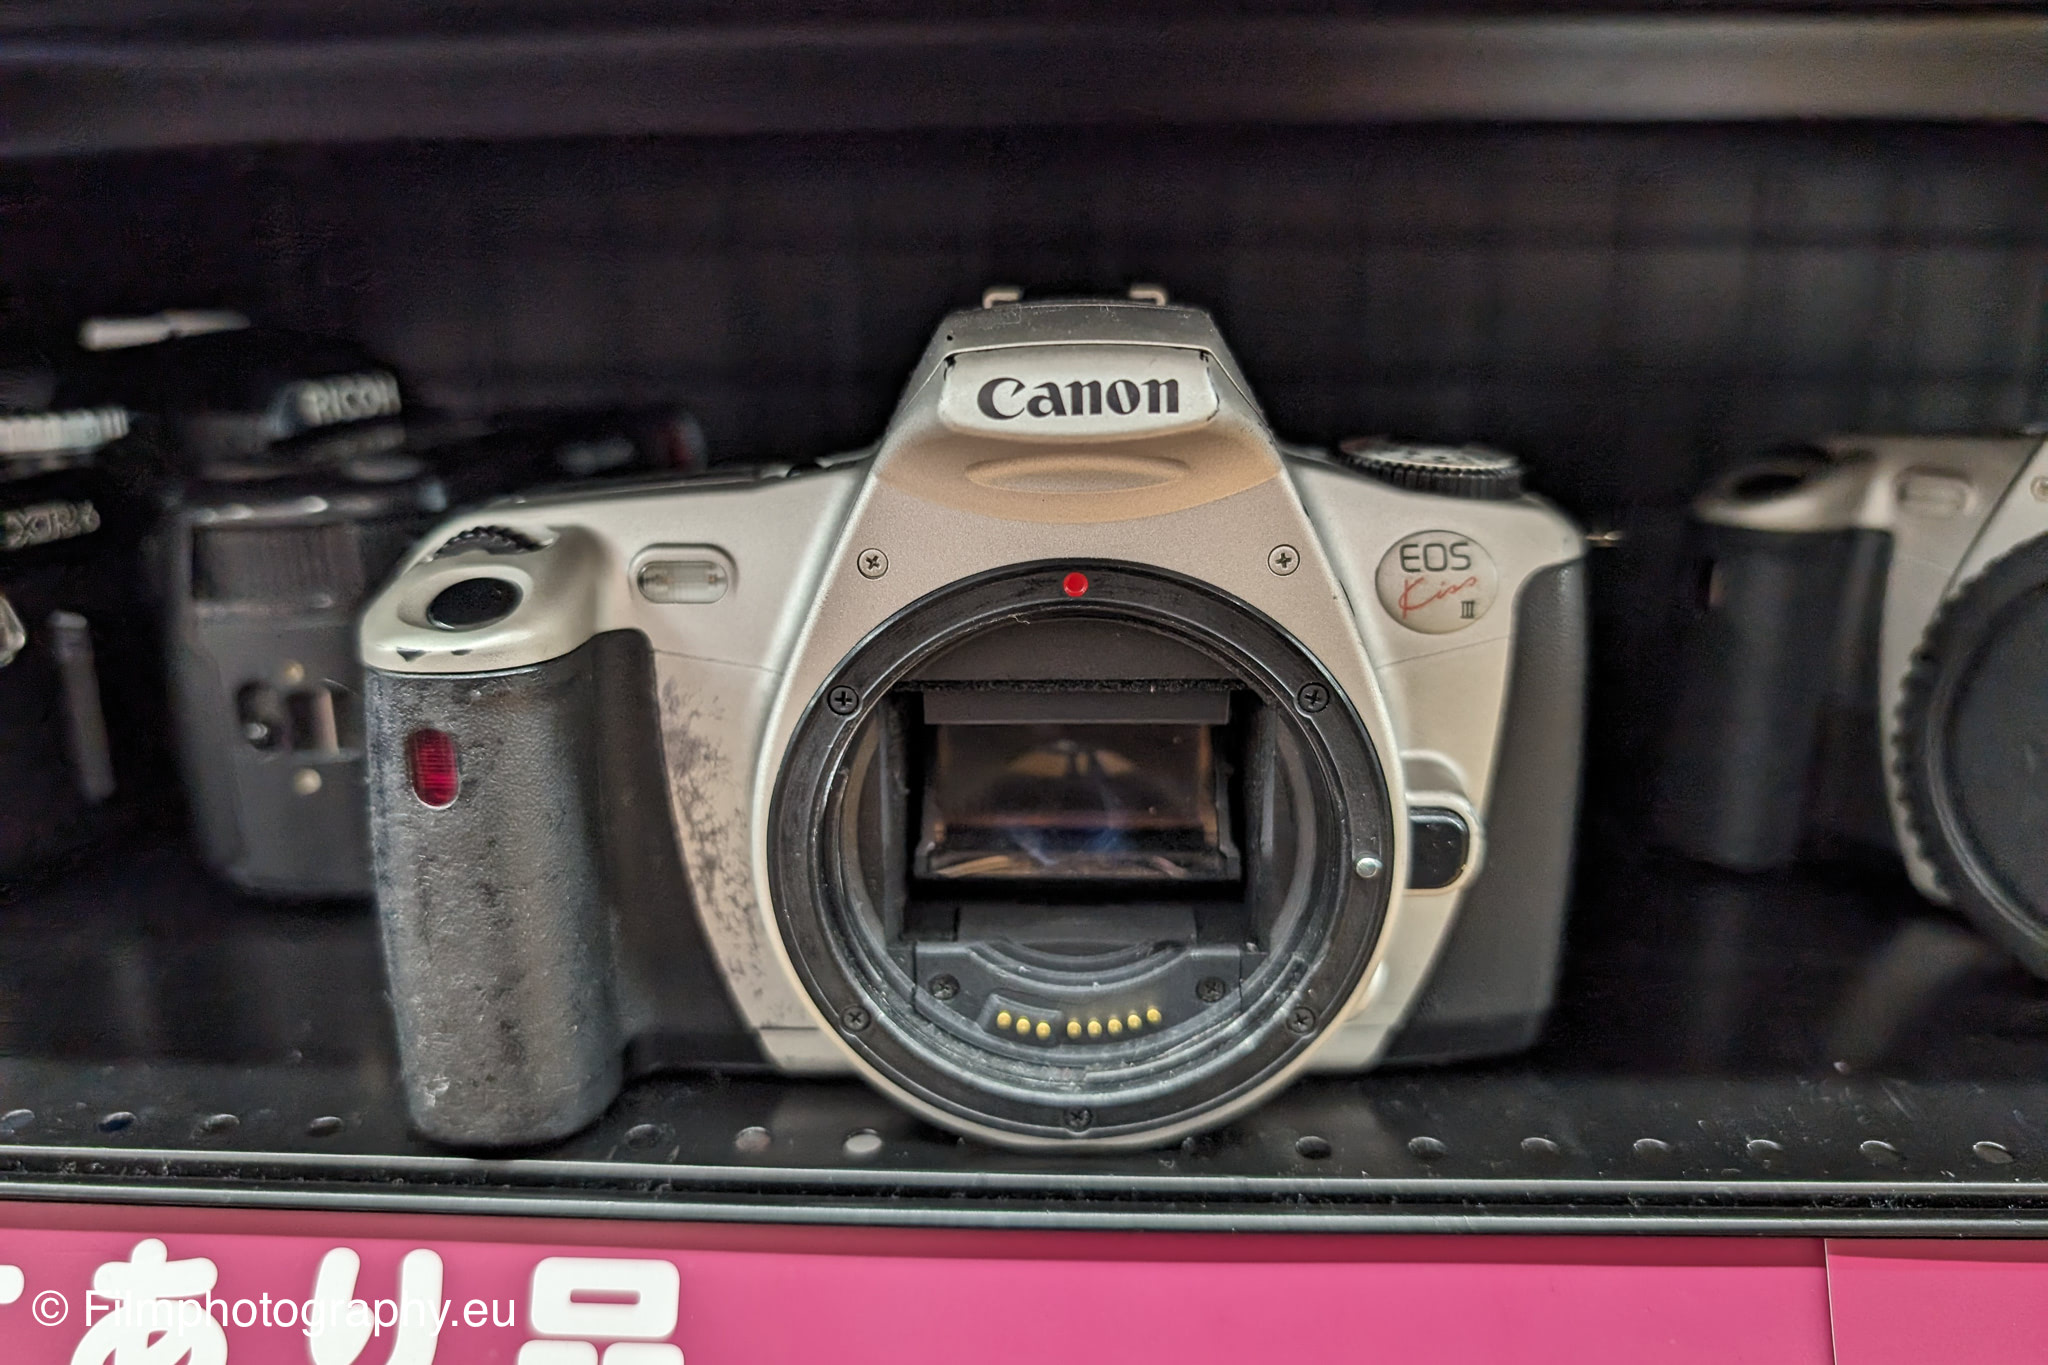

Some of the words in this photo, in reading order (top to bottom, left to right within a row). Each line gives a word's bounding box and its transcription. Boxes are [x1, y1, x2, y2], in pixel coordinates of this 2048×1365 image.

[977, 377, 1179, 420] Canon
[1400, 542, 1471, 572] EOS
[0, 1238, 685, 1365] あり品
